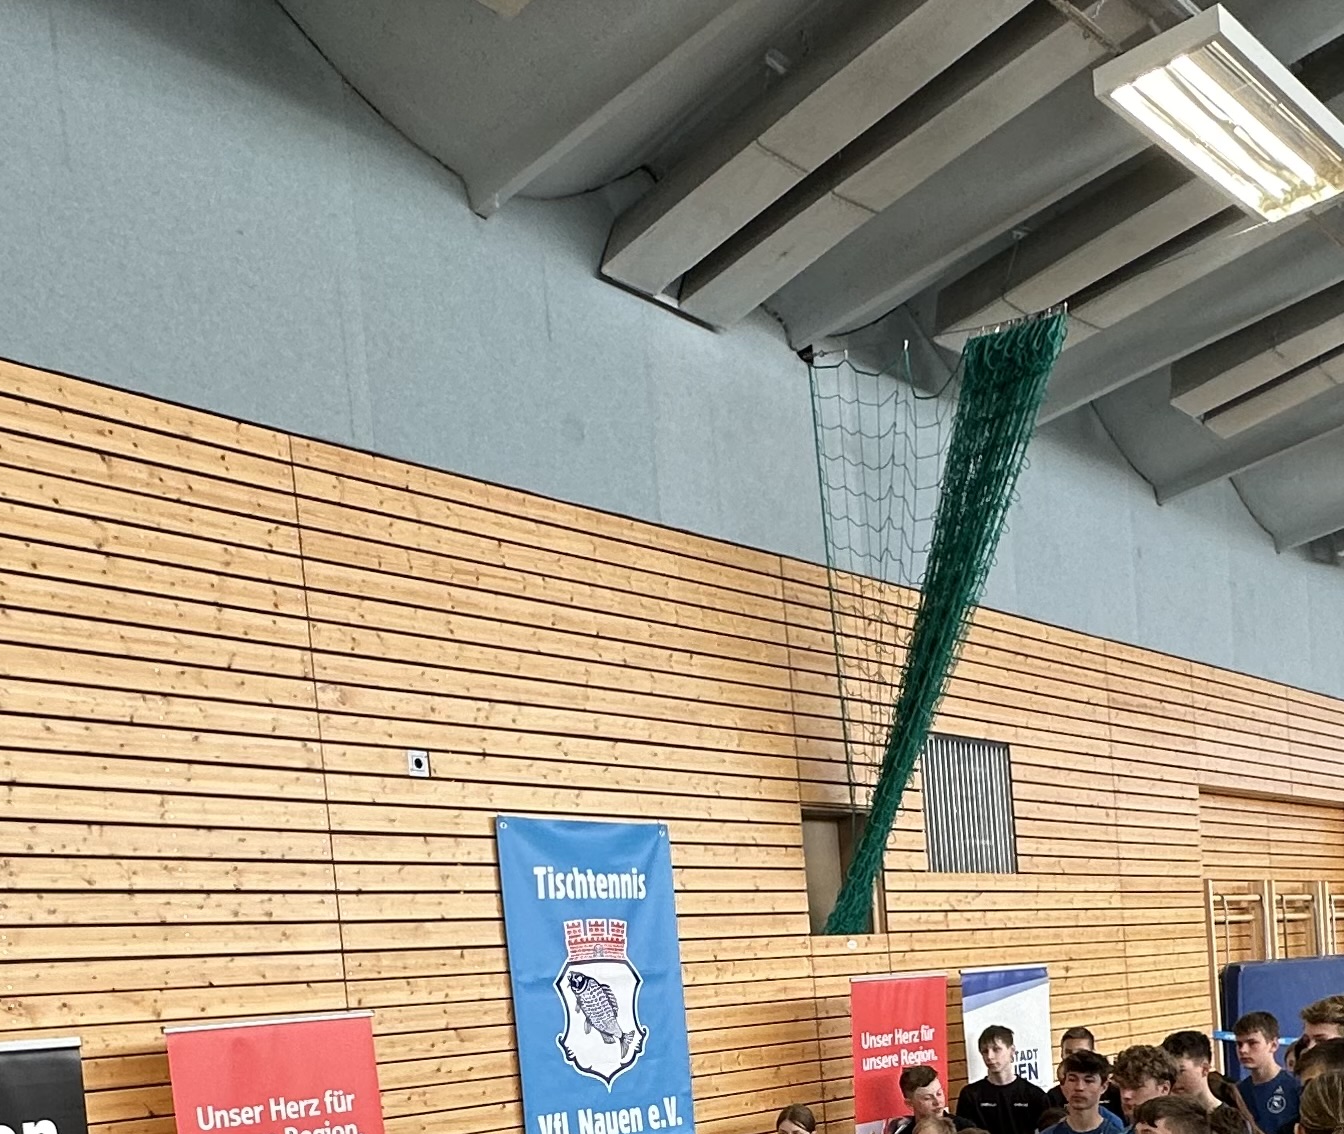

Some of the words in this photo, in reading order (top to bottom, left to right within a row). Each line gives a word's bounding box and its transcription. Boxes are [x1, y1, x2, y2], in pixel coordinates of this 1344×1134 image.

[533, 865, 647, 900] Tischtennis
[861, 1030, 893, 1049] Unser
[894, 1027, 920, 1046] Herz
[920, 1024, 936, 1042] für
[862, 1054, 899, 1072] unsere
[196, 1104, 264, 1131] Unser
[268, 1096, 321, 1121] Herz
[323, 1089, 355, 1114] für
[648, 1095, 683, 1128] e.V.
